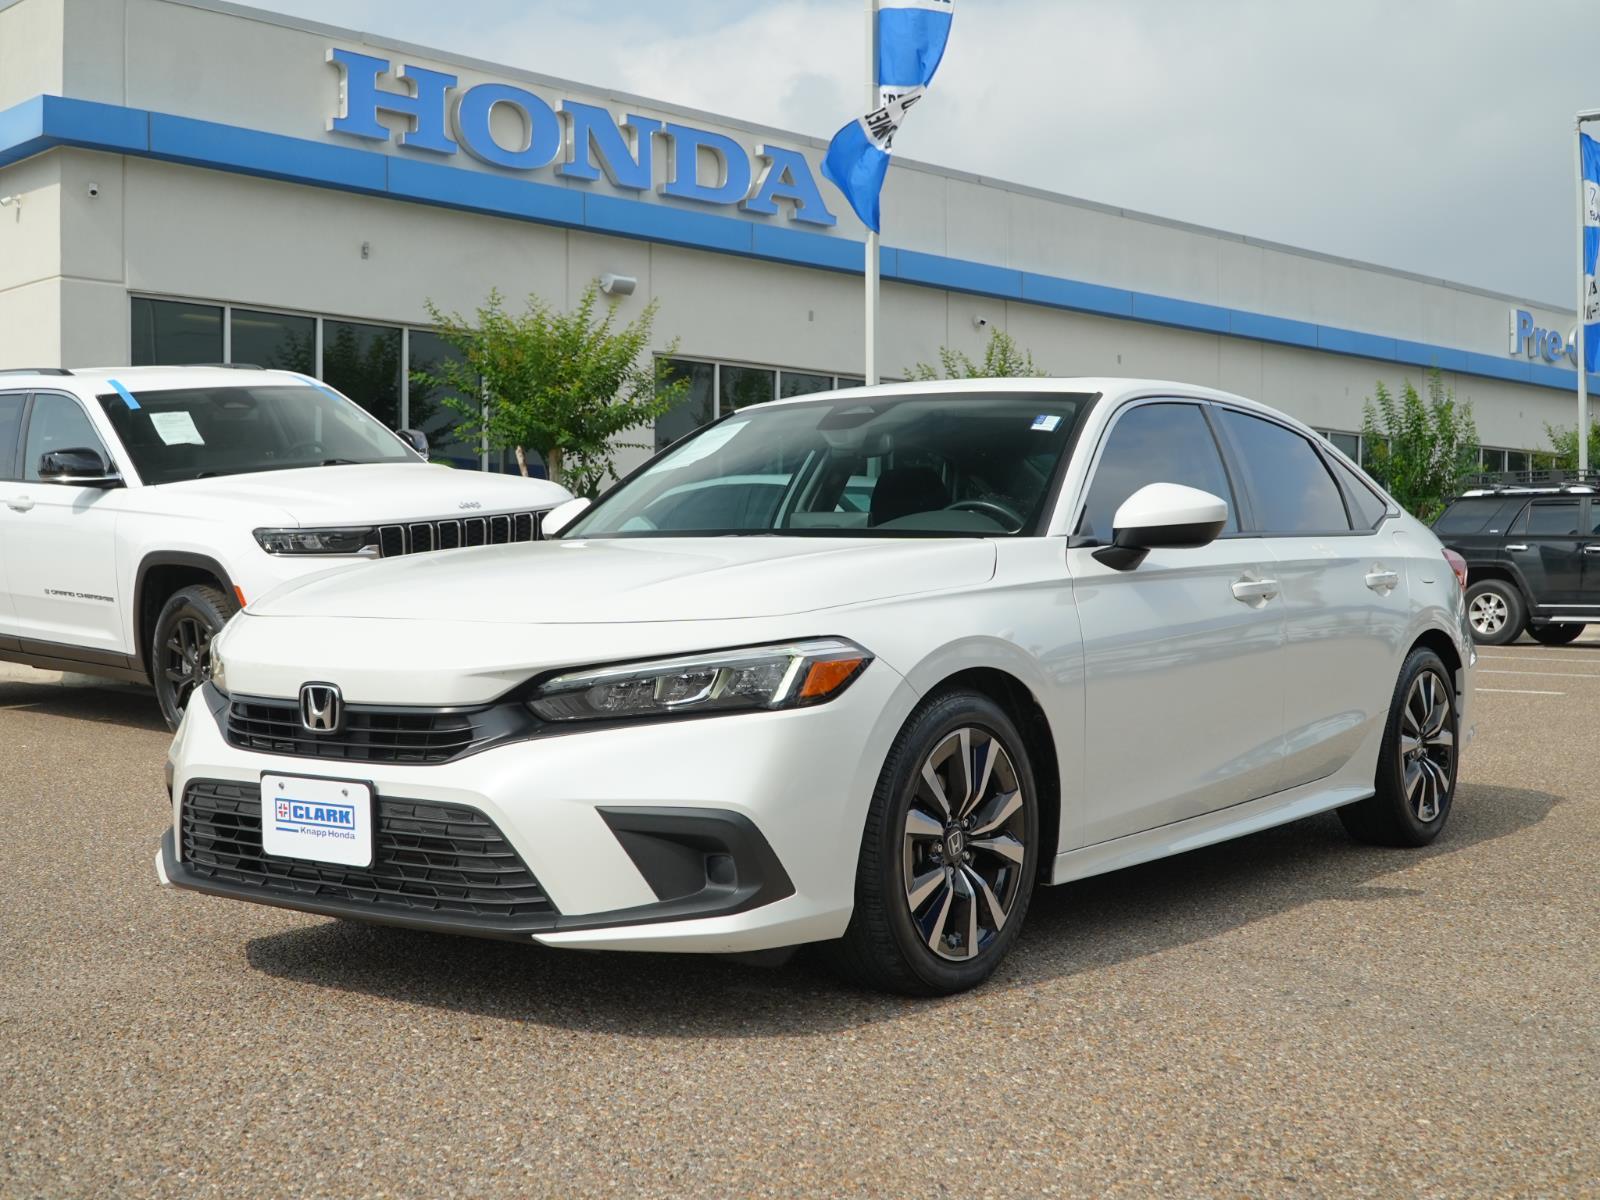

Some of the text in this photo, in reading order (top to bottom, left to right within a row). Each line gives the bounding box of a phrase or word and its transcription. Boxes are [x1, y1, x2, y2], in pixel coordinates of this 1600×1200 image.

[326, 48, 836, 226] HONDA
[293, 805, 351, 824] CLARK
[300, 827, 355, 840] Knapp Honda
